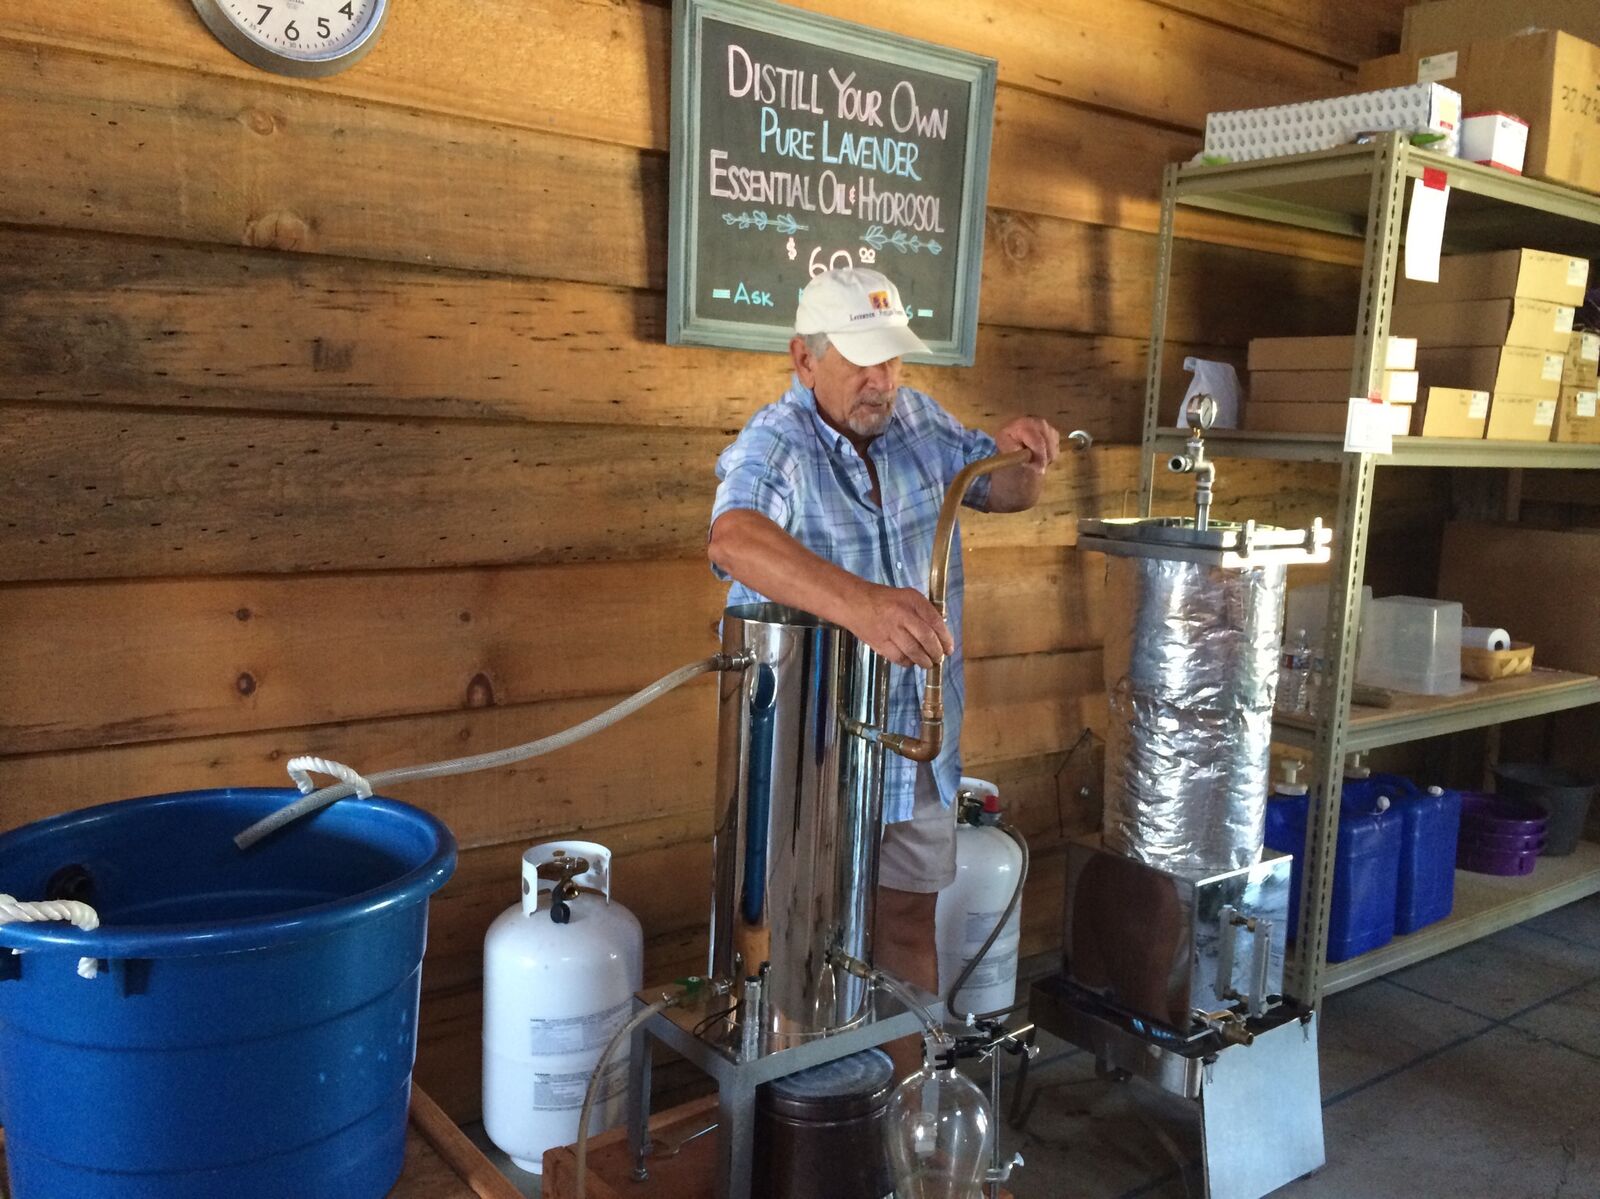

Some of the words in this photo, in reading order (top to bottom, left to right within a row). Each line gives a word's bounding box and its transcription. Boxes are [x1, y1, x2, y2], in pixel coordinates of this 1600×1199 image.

[257, 4, 273, 26] 7
[338, 0, 354, 20] 4
[284, 20, 300, 41] 6
[316, 17, 331, 39] 5
